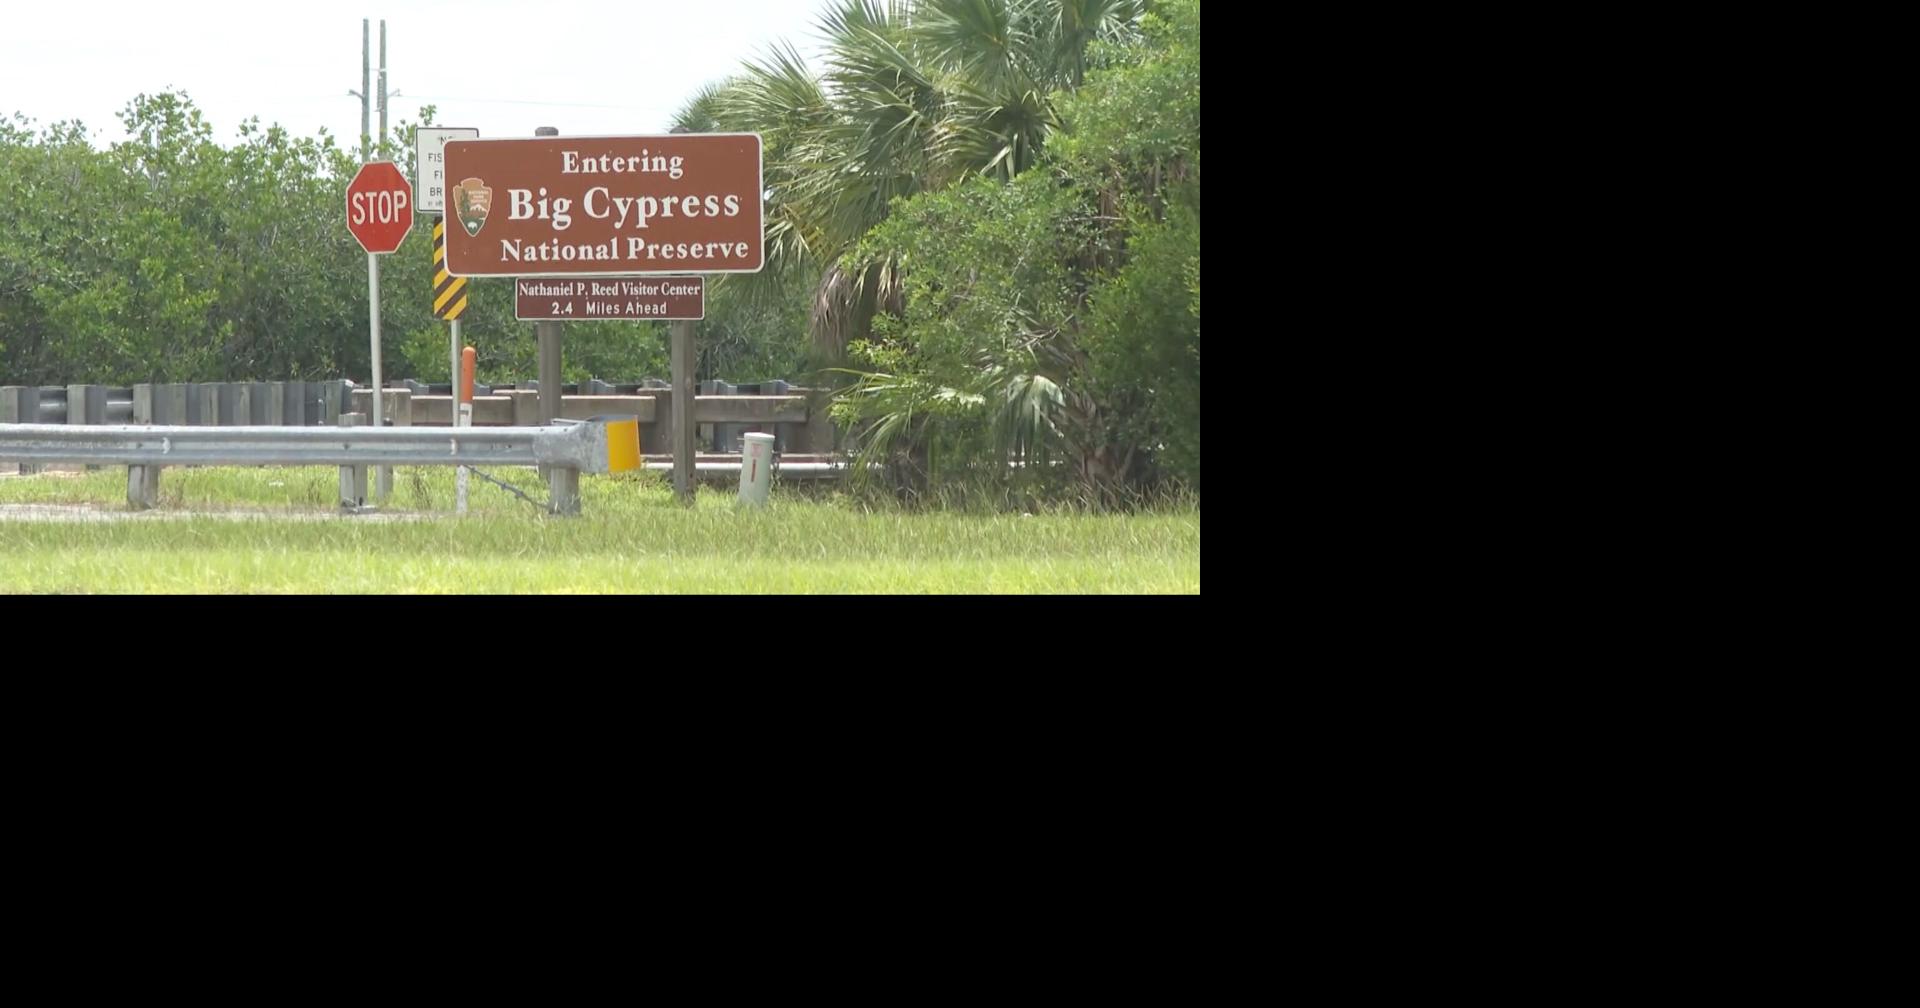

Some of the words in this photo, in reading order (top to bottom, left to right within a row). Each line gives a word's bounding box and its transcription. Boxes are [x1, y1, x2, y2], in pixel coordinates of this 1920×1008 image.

[561, 149, 684, 180] Entering
[352, 190, 408, 225] STOP
[507, 187, 573, 231] Big
[583, 186, 740, 230] Cypress
[500, 237, 620, 262] National
[626, 237, 749, 260] Preserve
[519, 282, 574, 296] Nathaniel
[591, 282, 619, 296] Reed
[621, 282, 659, 296] Visitor
[660, 282, 701, 296] Center
[551, 302, 573, 315] 2.4
[586, 302, 620, 315] Miles
[625, 302, 667, 315] Ahead
